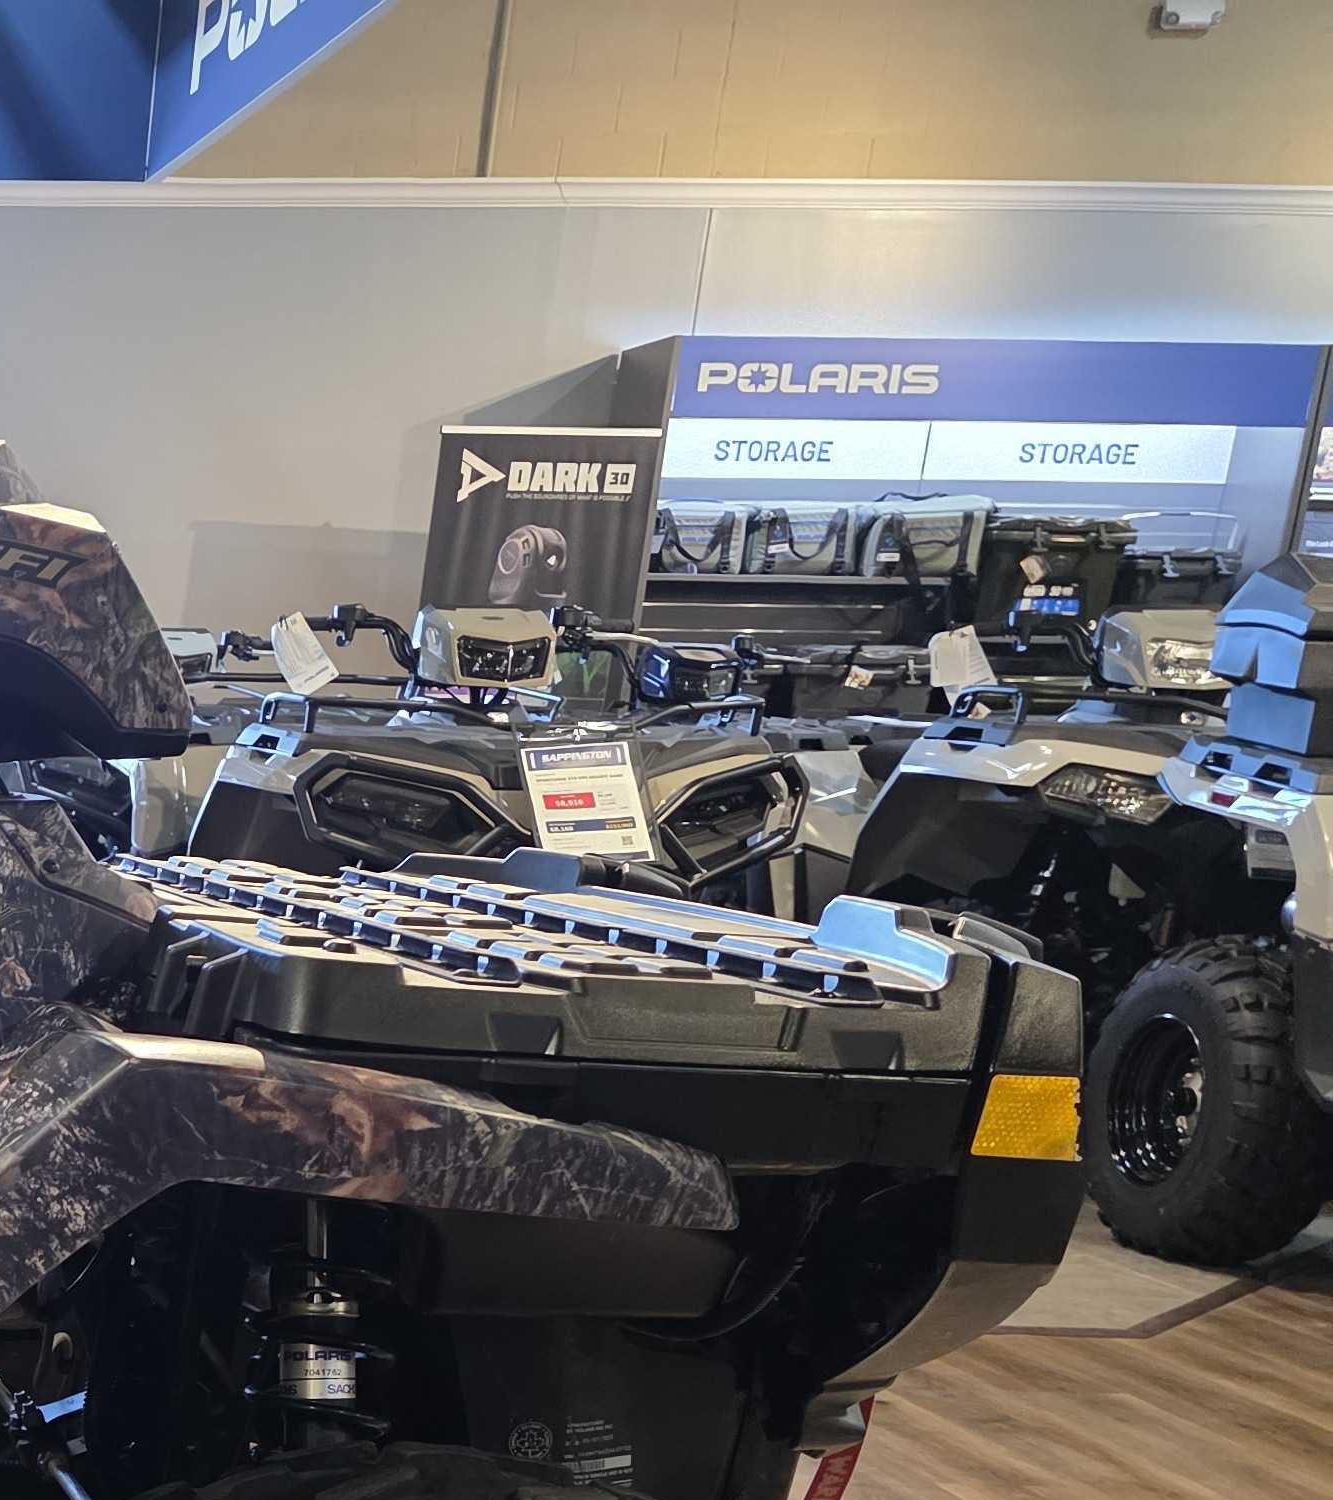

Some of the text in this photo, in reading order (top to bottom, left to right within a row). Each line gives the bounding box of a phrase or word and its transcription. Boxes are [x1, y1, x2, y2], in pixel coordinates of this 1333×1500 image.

[697, 362, 940, 394] POLARIS
[714, 440, 833, 462] STORAGE
[1019, 442, 1139, 466] STORAGE
[507, 461, 630, 493] DARK 30
[541, 750, 612, 763] SAPPINGTON
[284, 1351, 351, 1360] POLARIS
[327, 1384, 357, 1395] SACH
